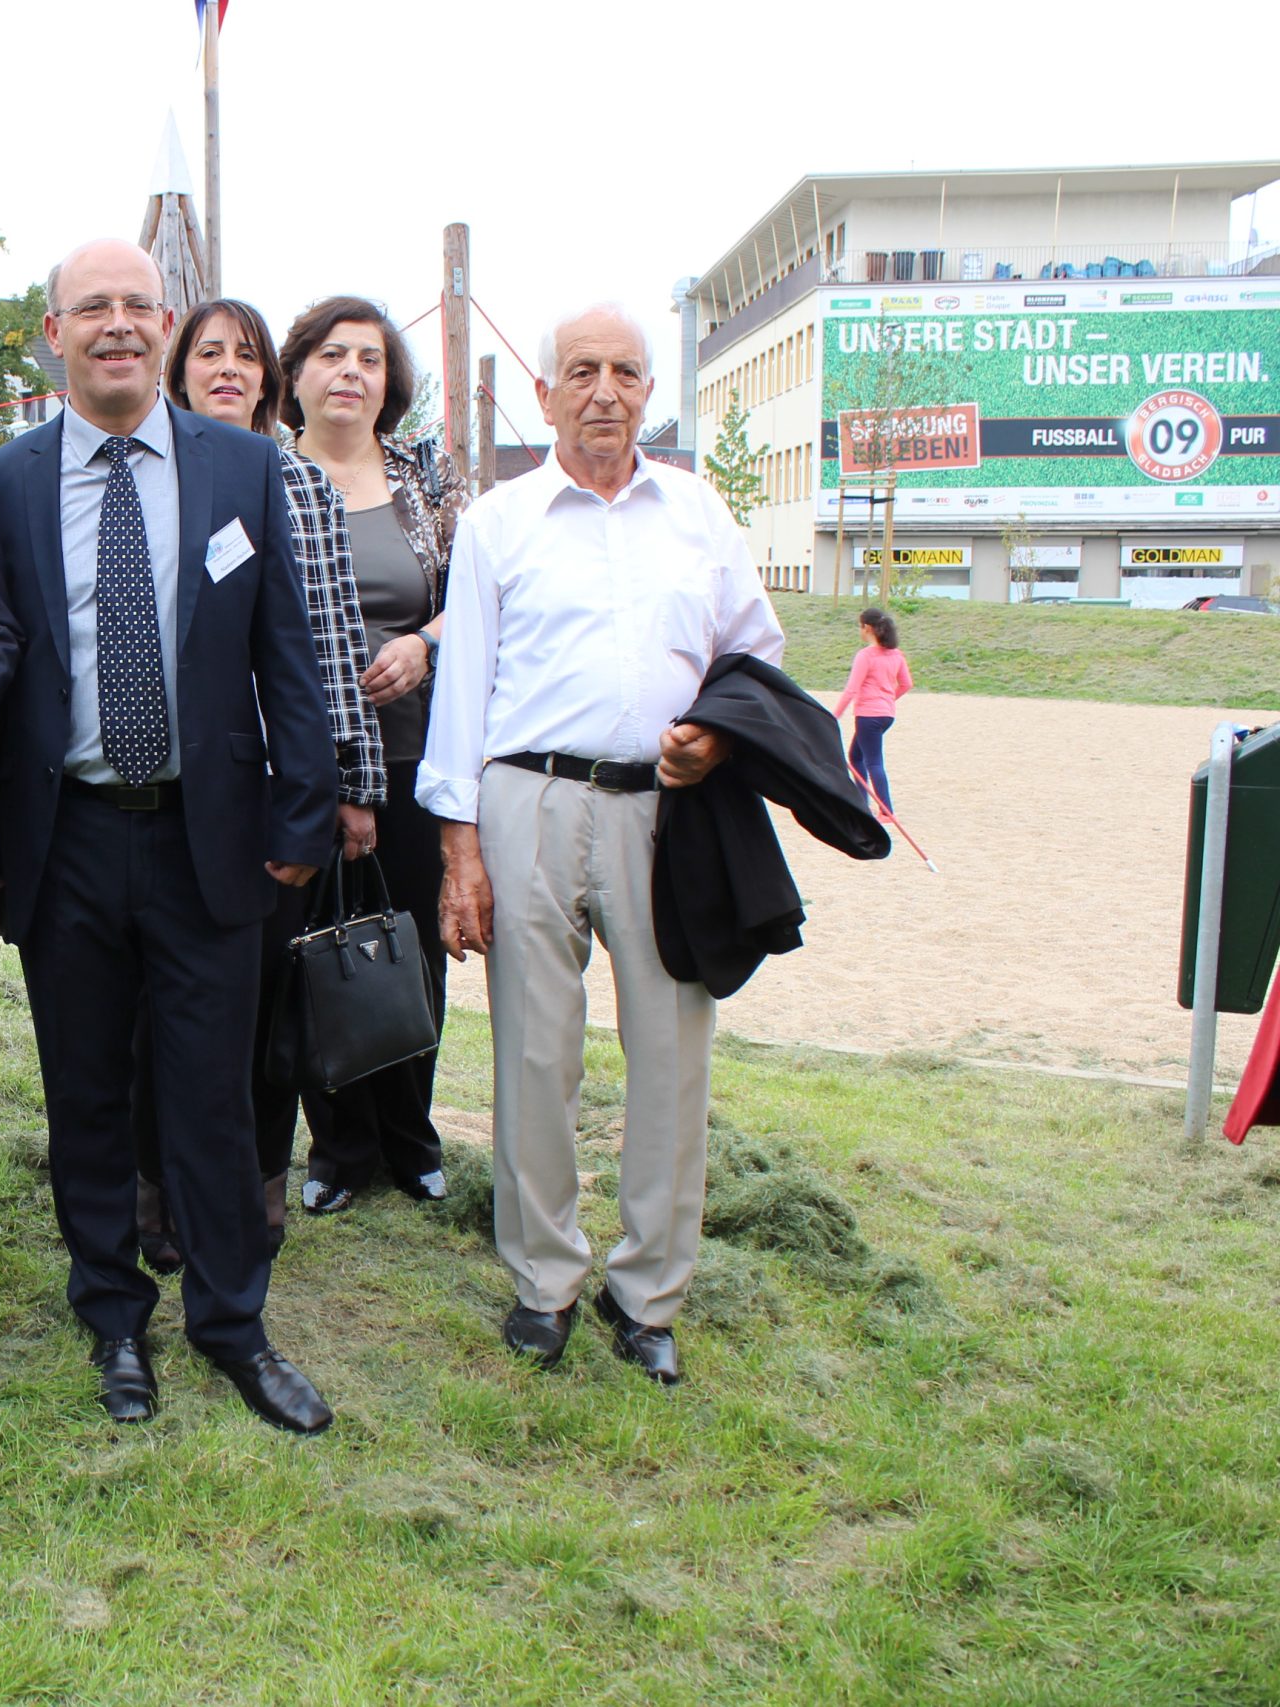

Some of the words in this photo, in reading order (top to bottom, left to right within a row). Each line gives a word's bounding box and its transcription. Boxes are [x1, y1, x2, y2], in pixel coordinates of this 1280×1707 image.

[839, 320, 964, 353] UNSERE
[973, 318, 1078, 351] STADT
[1023, 354, 1130, 386] UNSER
[1141, 351, 1269, 384] VEREIN.
[1140, 394, 1209, 419] BERGISCH
[1032, 428, 1117, 447] FUSSBALL
[1149, 418, 1199, 454] 09
[1230, 427, 1266, 445] PUR
[1138, 454, 1208, 478] GLADBACH
[1132, 549, 1222, 563] GOLDMAN
